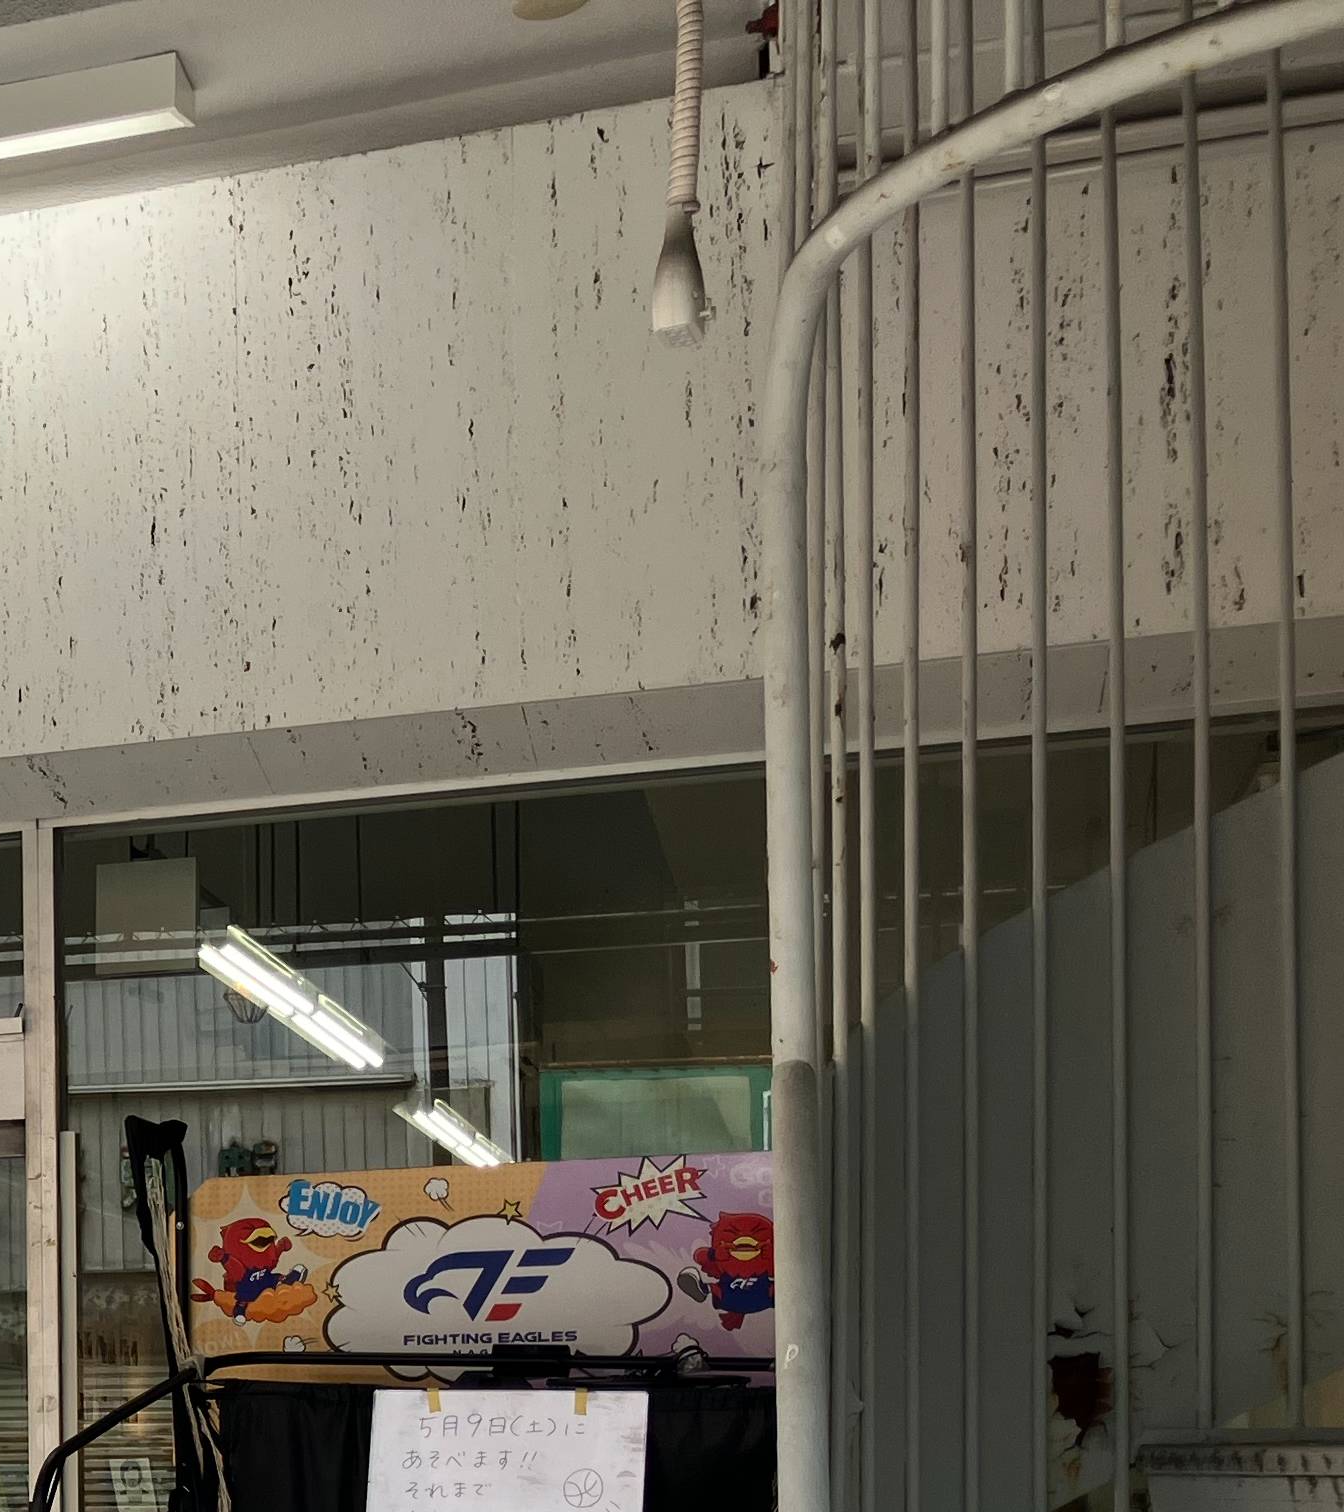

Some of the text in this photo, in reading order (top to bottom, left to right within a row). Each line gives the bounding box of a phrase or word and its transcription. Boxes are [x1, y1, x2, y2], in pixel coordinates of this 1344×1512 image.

[288, 1179, 382, 1231] ENJOY
[594, 1167, 702, 1221] CHEER
[403, 1330, 578, 1346] FIGHTING EAGLES
[405, 1481, 492, 1498] それまで
